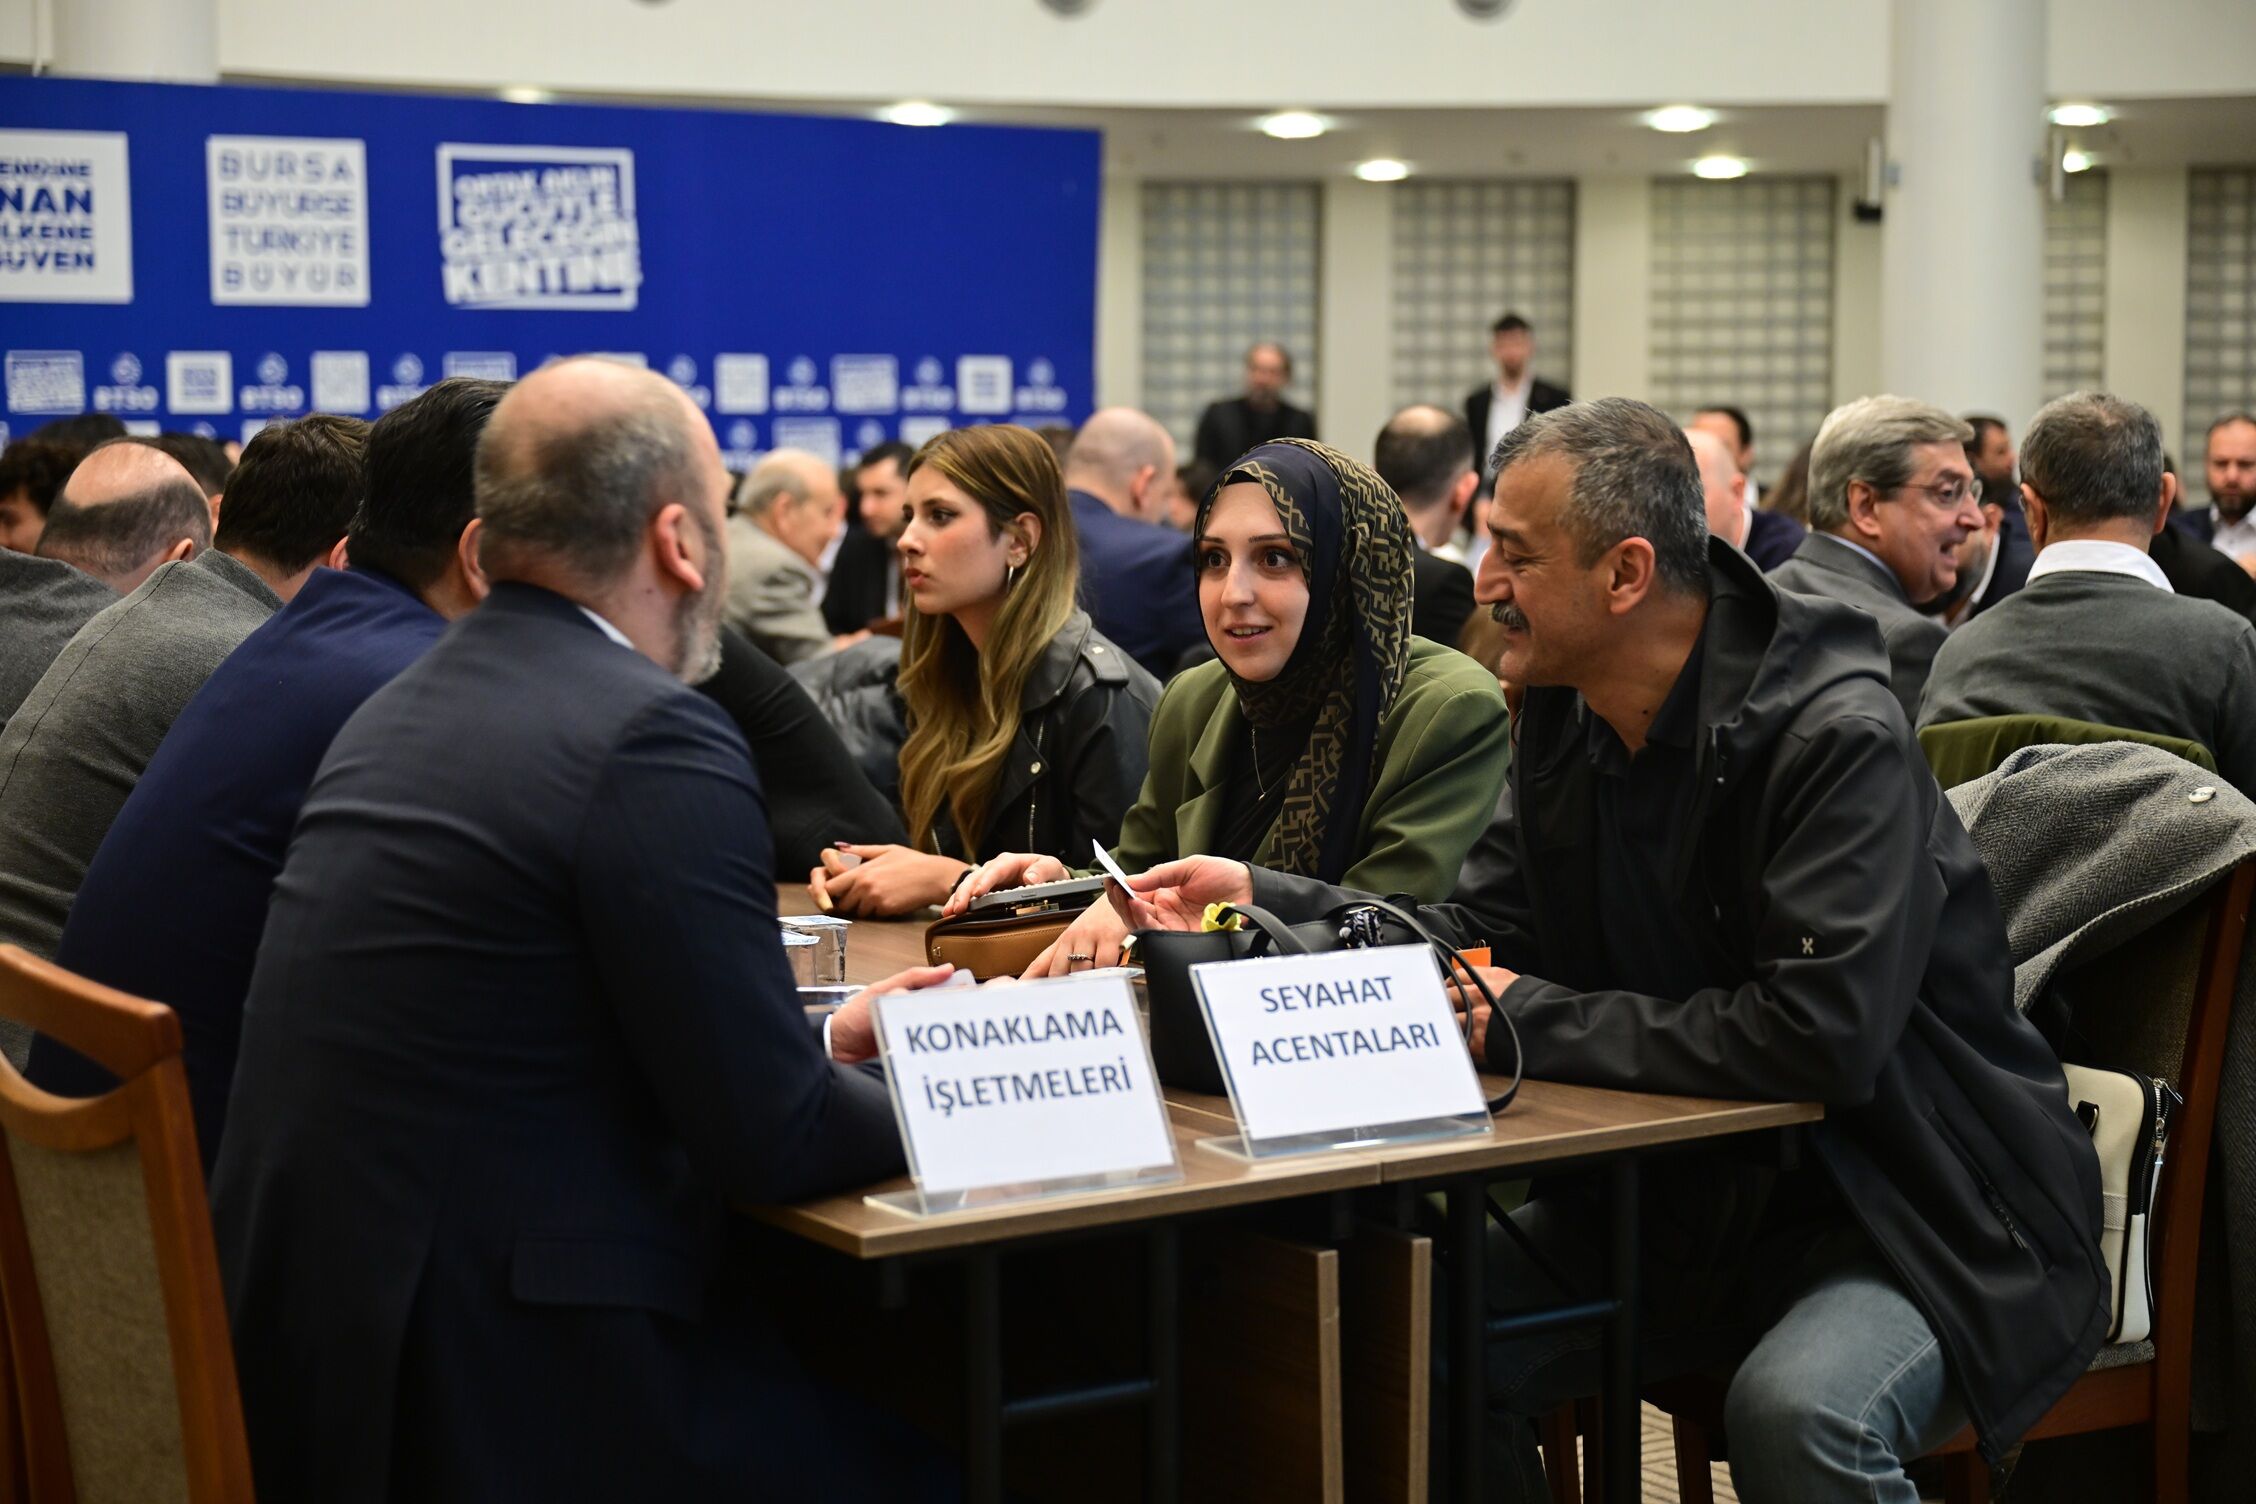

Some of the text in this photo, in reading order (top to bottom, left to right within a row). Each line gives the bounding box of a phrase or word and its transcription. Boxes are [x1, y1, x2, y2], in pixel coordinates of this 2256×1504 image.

[218, 148, 355, 184] BURSA
[0, 250, 95, 273] ÜVEN
[1260, 976, 1392, 1013] SEYAHAT
[904, 1008, 1124, 1054] KONAKLAMA
[1252, 1022, 1441, 1066] ACENTALARI
[922, 1056, 1133, 1117] İŞLETMELERİ
